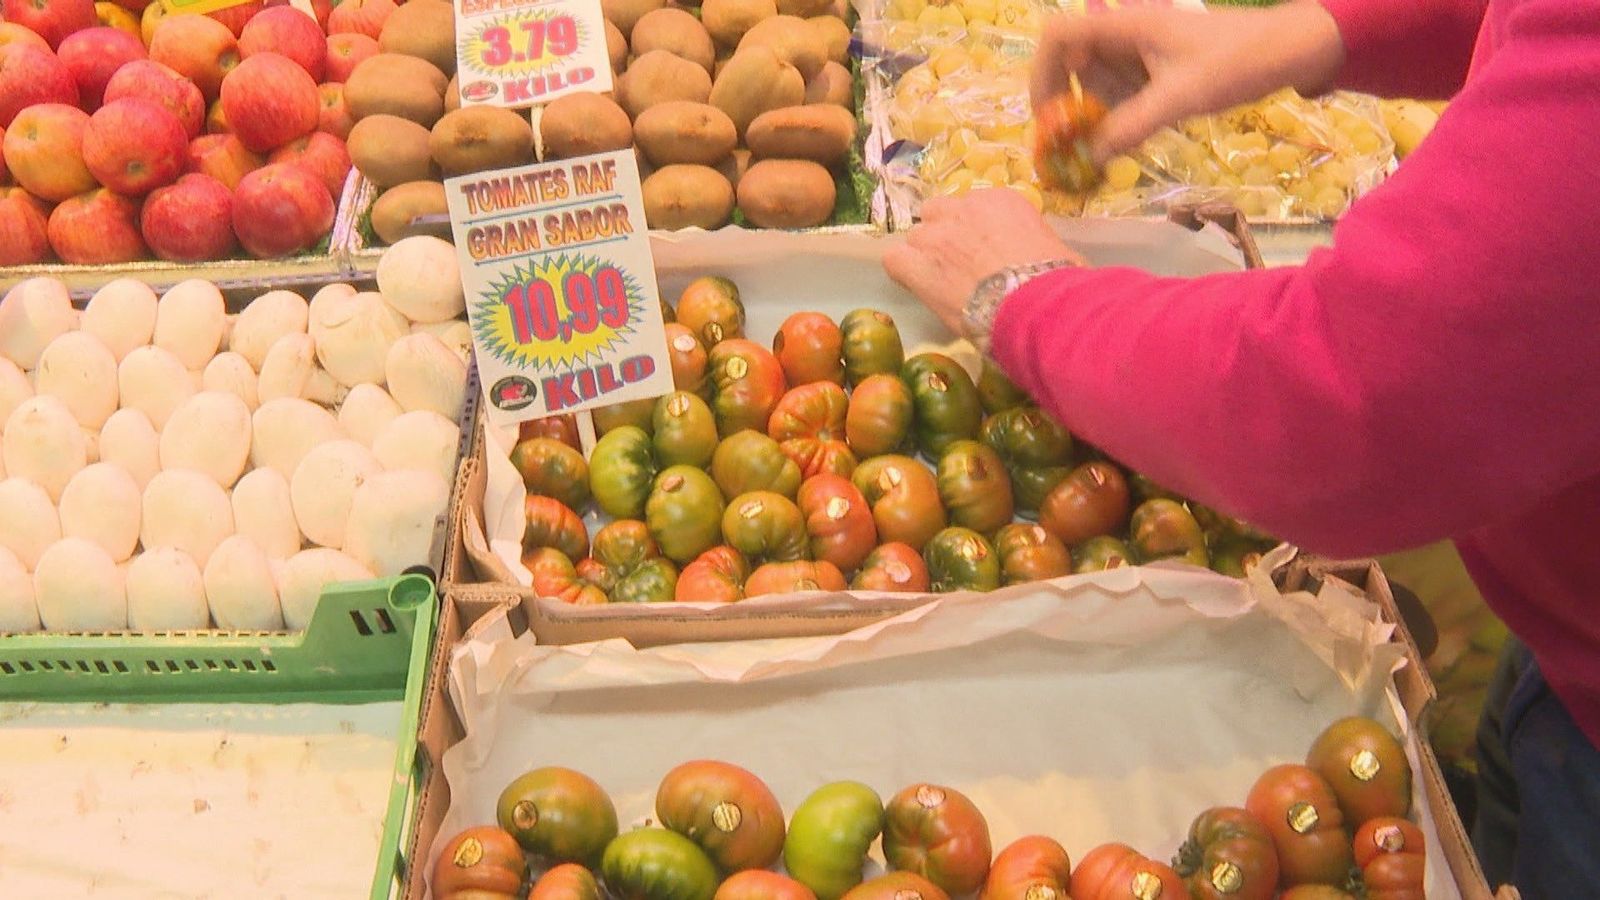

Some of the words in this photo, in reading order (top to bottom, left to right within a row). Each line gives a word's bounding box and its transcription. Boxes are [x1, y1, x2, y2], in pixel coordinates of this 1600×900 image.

[482, 16, 578, 67] 3.79
[502, 66, 595, 103] KILO
[460, 167, 570, 215] TOMATES
[571, 159, 617, 196] RAF
[467, 217, 541, 260] GRAN
[543, 203, 634, 247] SABOR
[503, 266, 630, 345] 10,99
[541, 354, 656, 412] KILO
